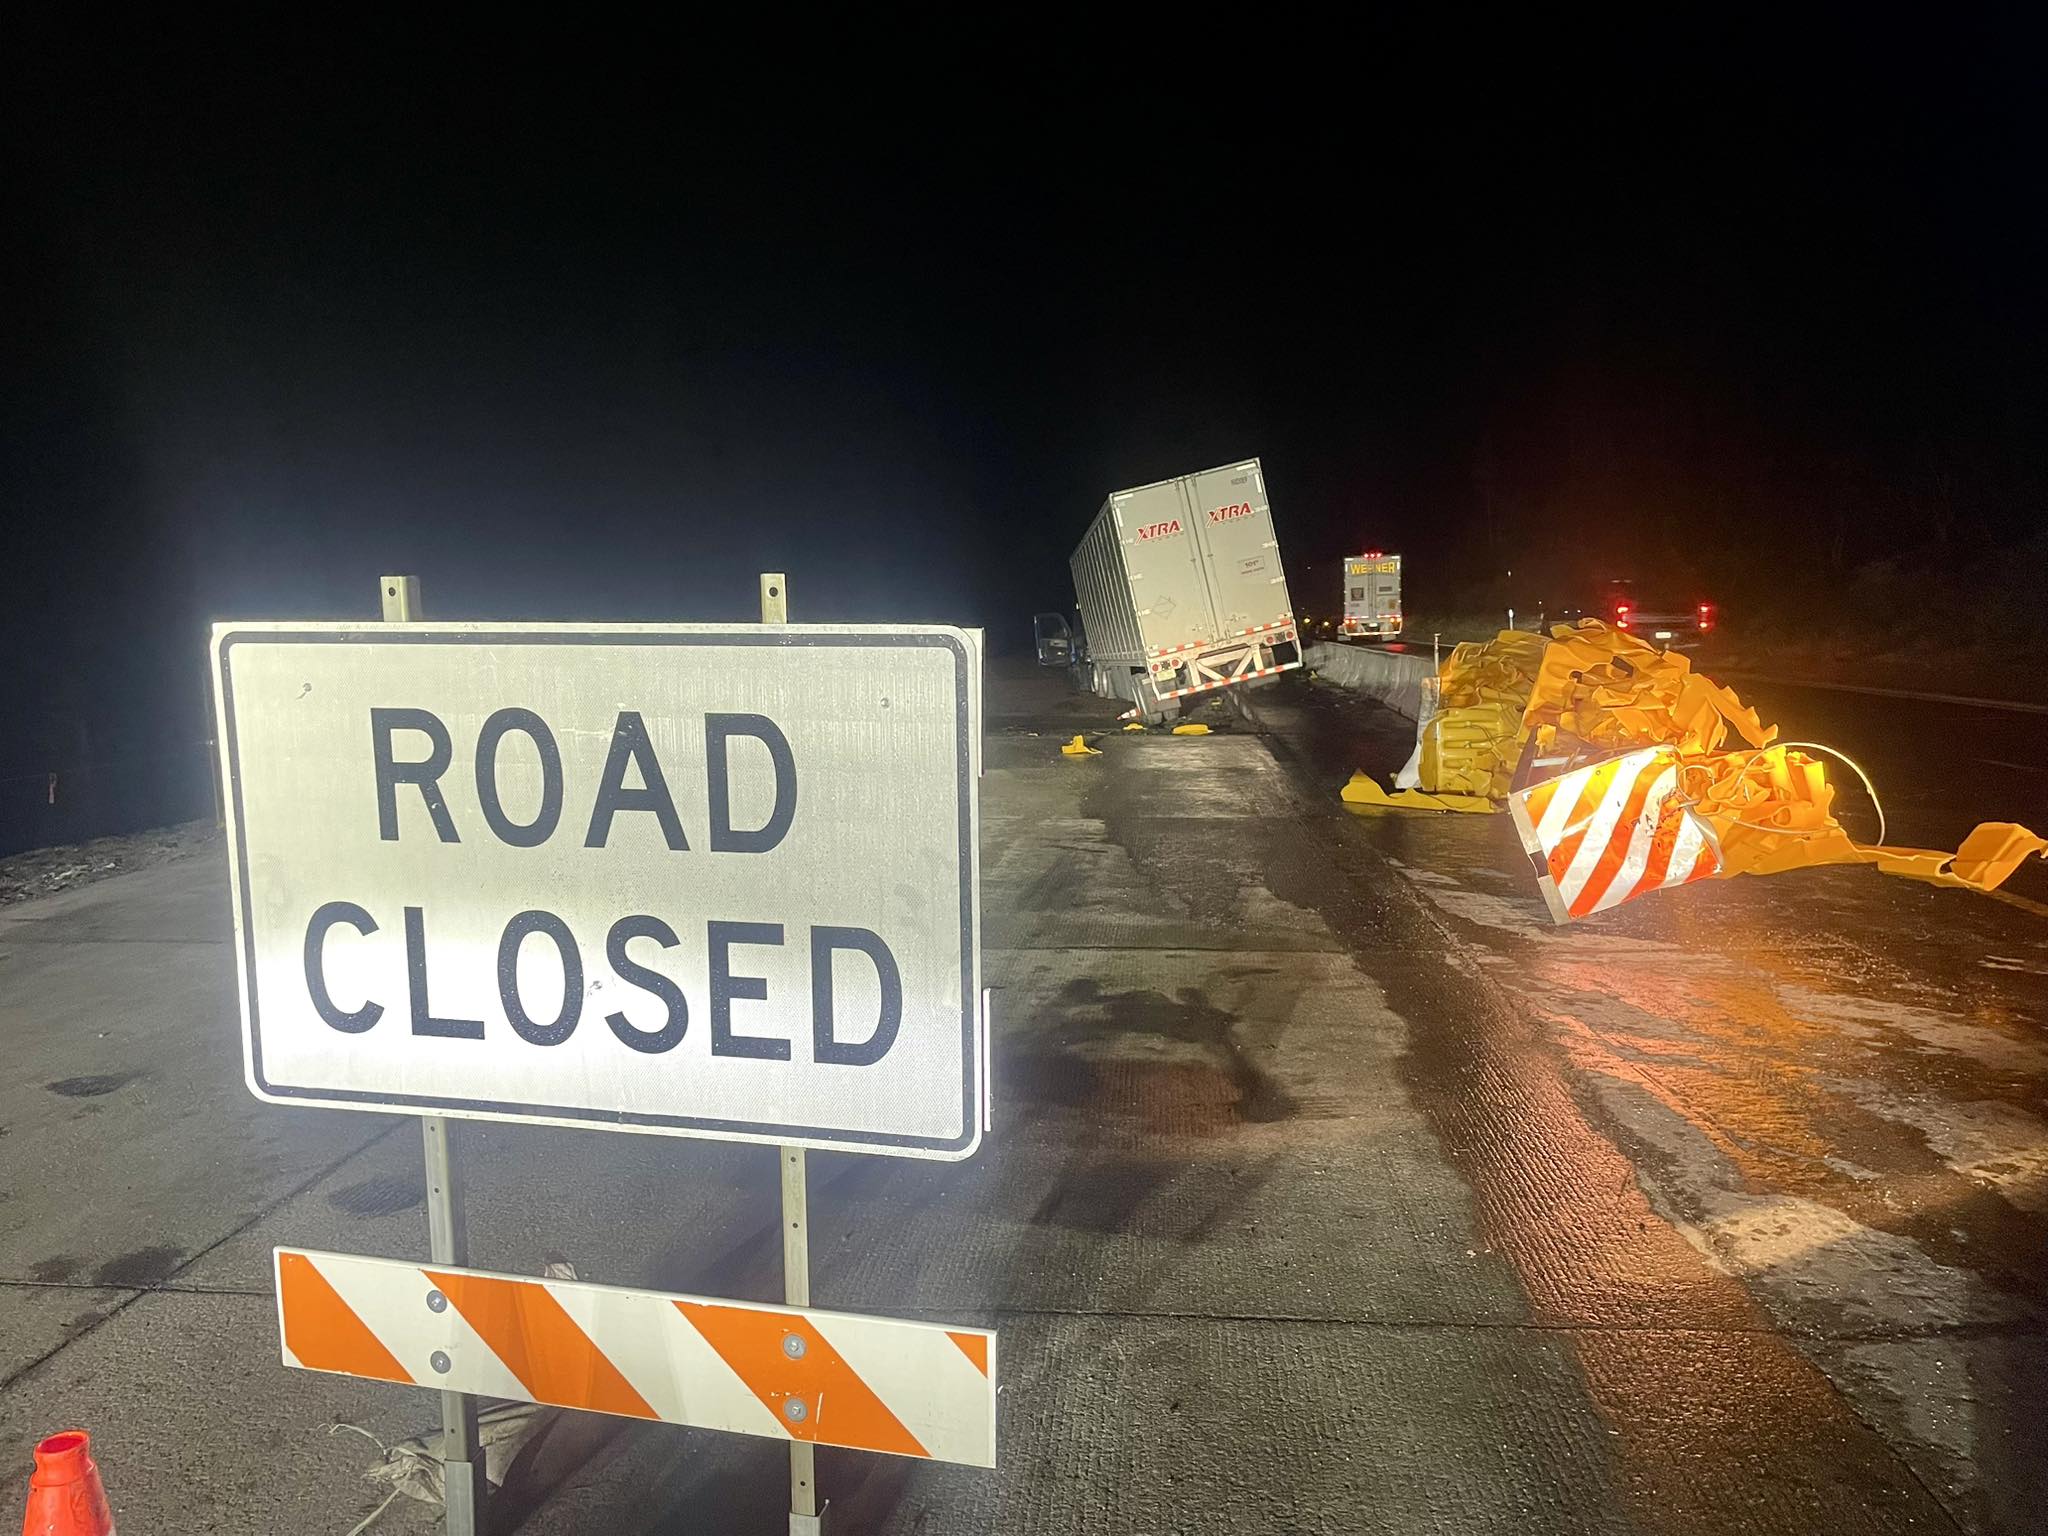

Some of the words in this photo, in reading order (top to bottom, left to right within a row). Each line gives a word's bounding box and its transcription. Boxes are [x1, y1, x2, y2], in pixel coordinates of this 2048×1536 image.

[1206, 501, 1252, 528] XTRA
[1135, 519, 1180, 545] XTRA
[1350, 561, 1395, 575] WENER
[370, 707, 798, 853] ROAD
[303, 901, 903, 1066] CLOSED
